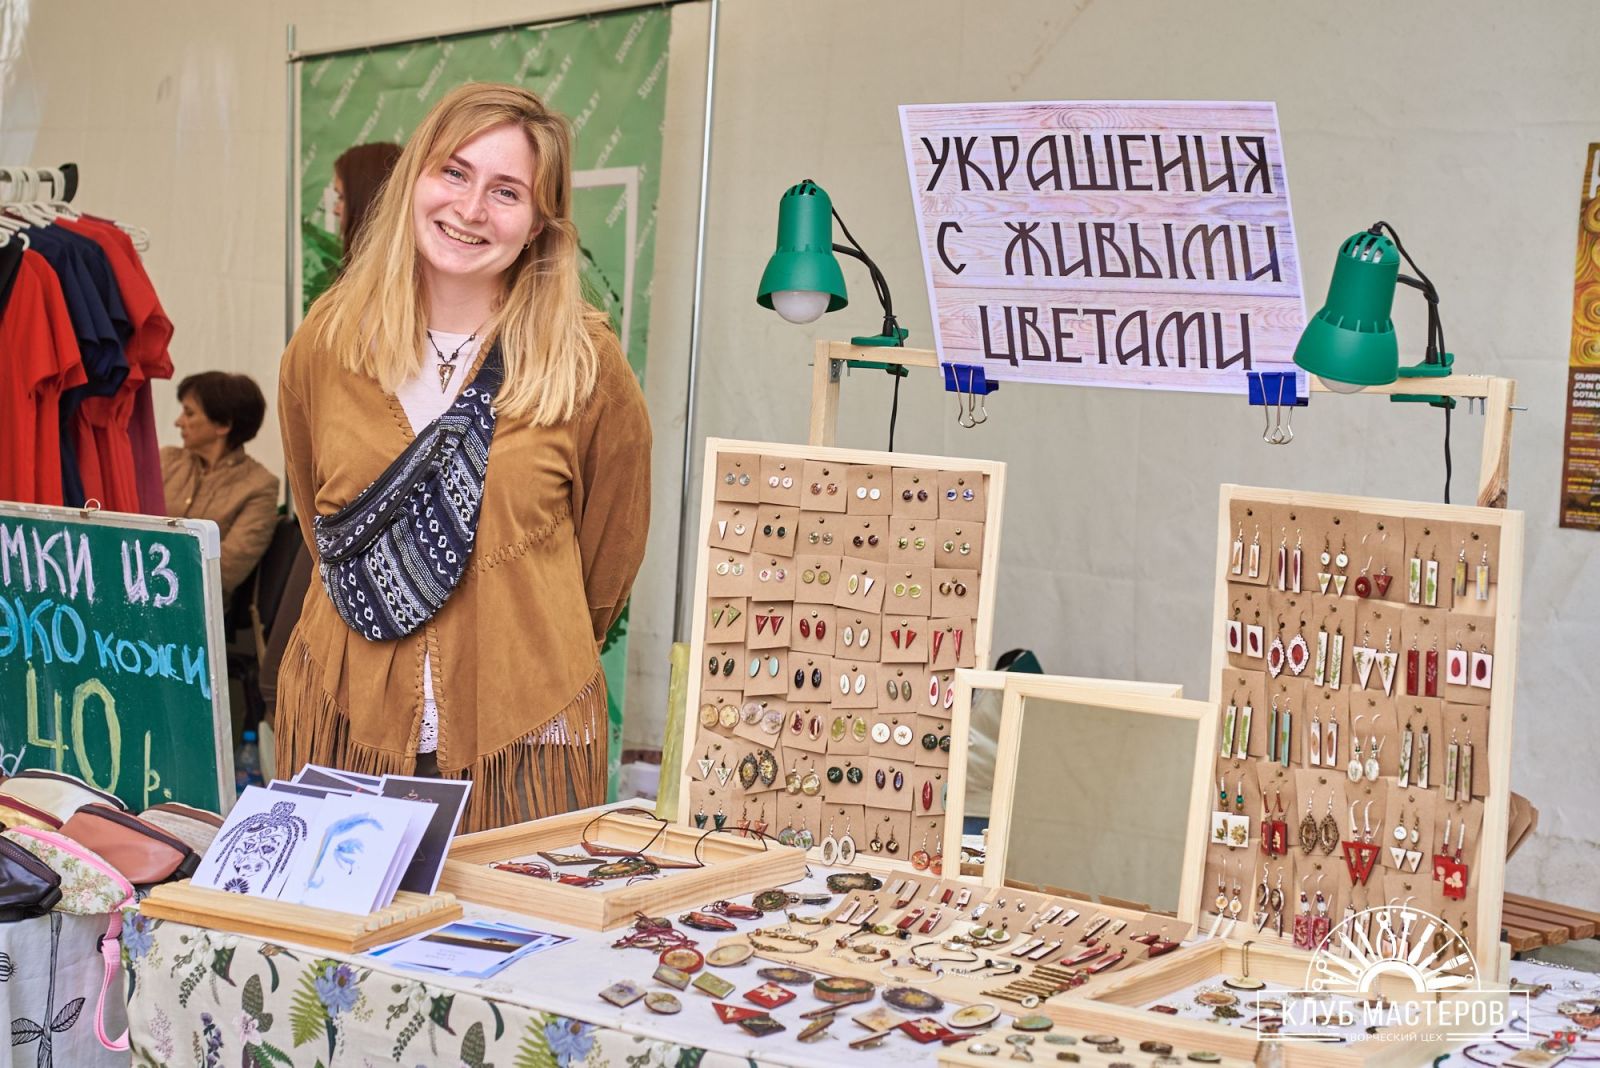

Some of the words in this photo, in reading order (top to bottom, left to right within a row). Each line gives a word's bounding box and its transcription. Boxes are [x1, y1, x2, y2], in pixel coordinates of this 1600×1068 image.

[919, 134, 1273, 194] УКРАШЕНИЯ
[936, 221, 967, 275] С
[1003, 221, 1283, 283] ЖИВЫМИ
[978, 304, 1253, 371] ЦВЕТАМИ
[121, 539, 179, 608] ИЗ
[26, 660, 121, 795] 40
